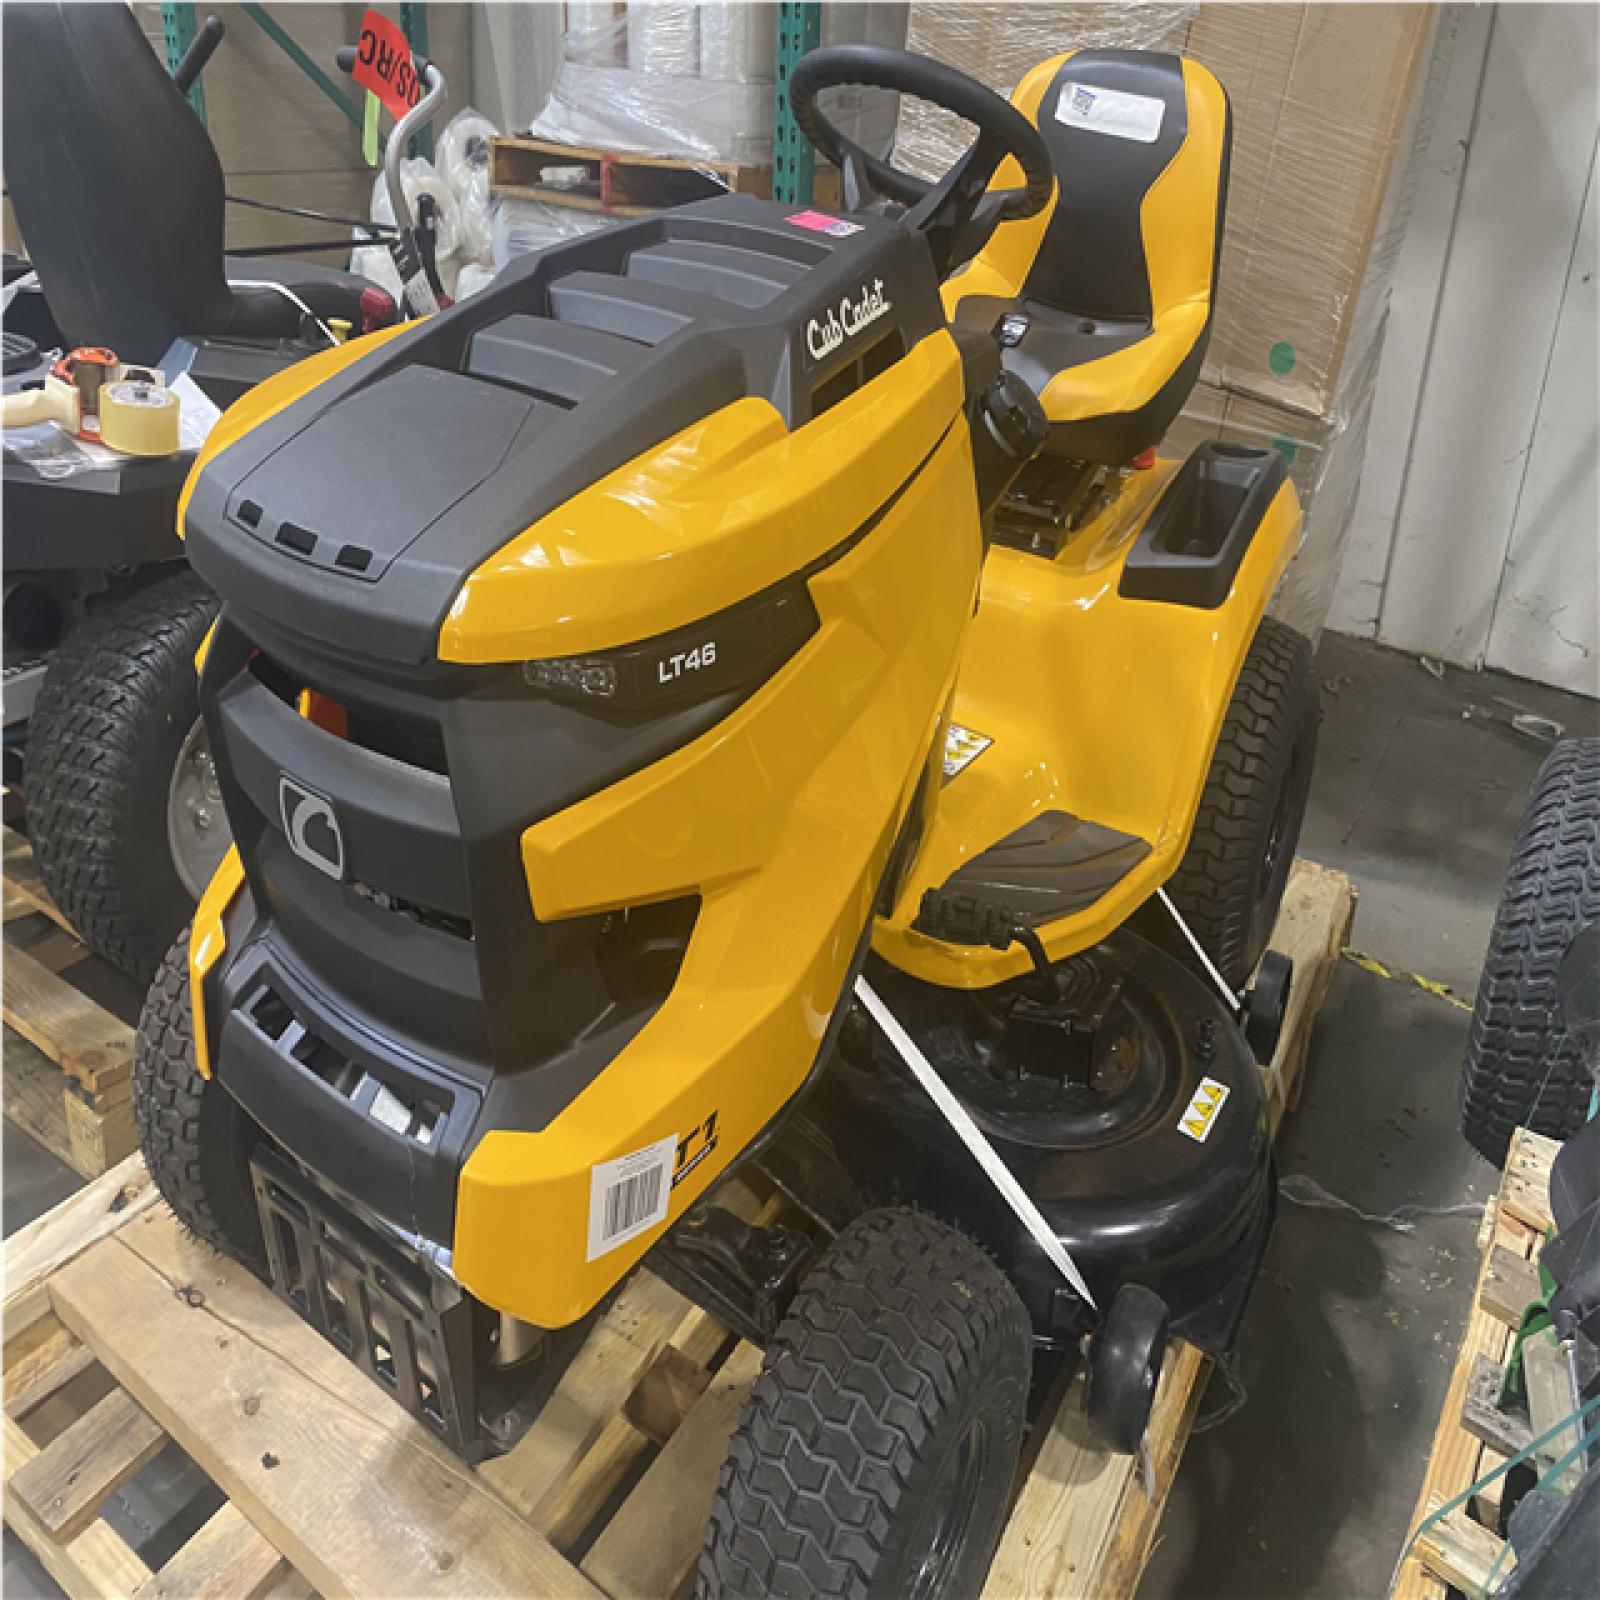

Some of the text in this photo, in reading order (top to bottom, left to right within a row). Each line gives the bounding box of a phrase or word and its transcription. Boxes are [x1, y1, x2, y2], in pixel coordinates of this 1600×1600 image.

[807, 278, 893, 360] Cub Cadet
[659, 641, 716, 683] LT46
